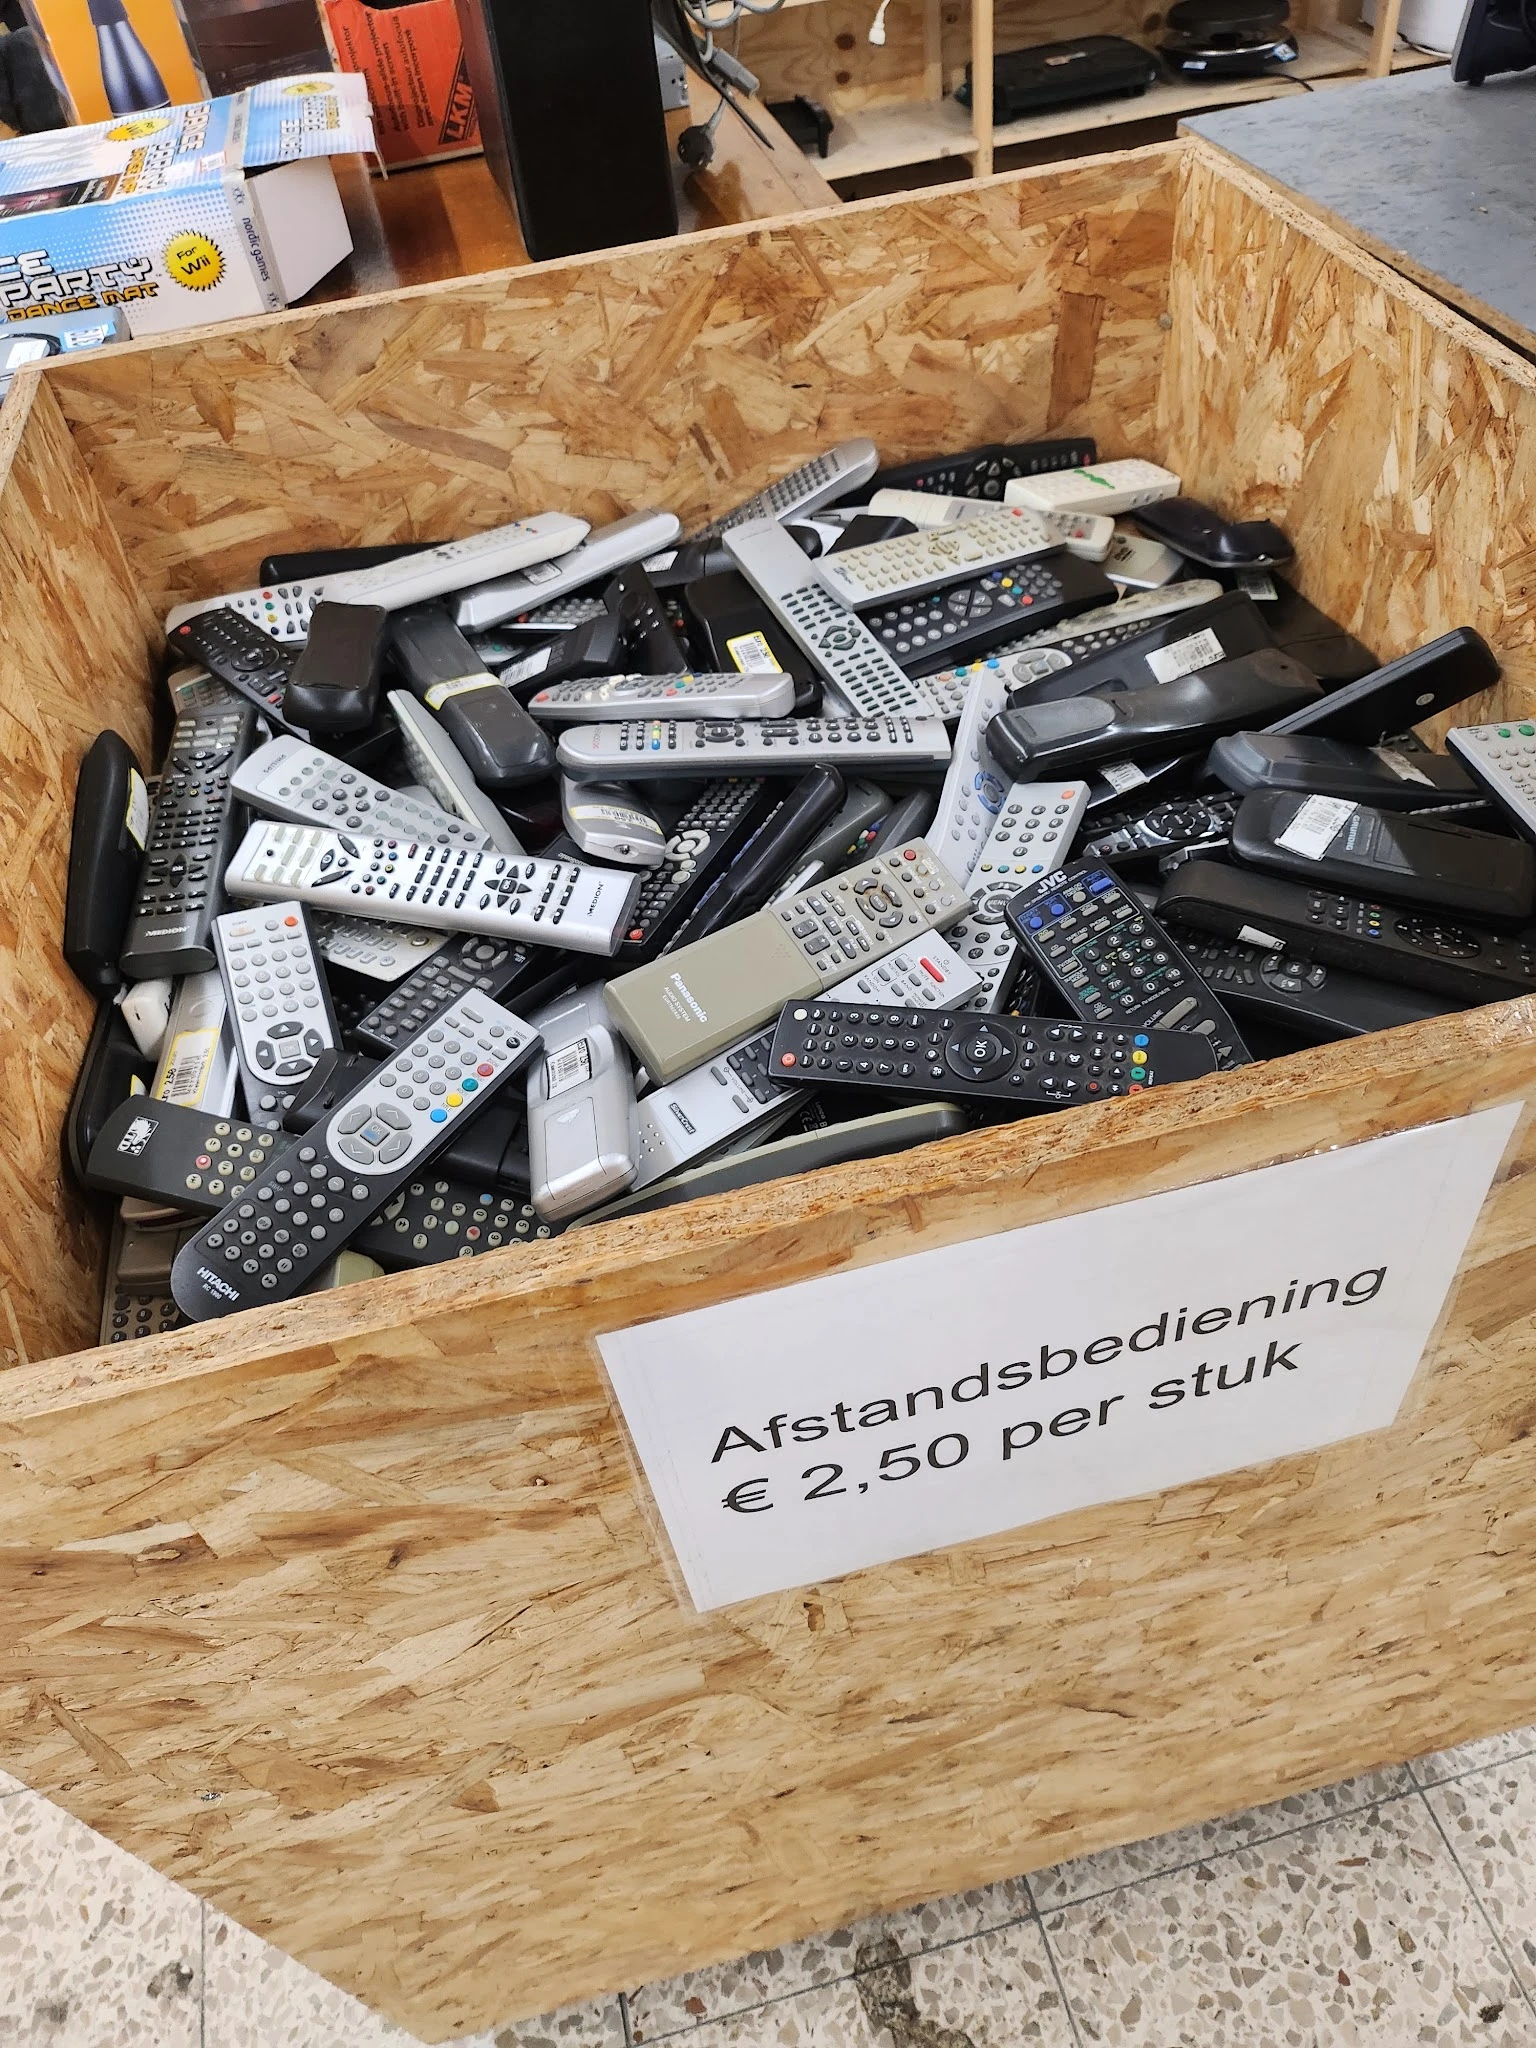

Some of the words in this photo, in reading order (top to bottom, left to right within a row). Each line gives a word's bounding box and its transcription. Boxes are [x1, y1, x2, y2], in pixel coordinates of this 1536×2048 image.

[364, 11, 384, 57] projector
[382, 42, 396, 74] screen
[445, 82, 473, 139] LKM
[242, 217, 260, 248] nordic
[177, 246, 197, 260] For
[180, 254, 211, 275] Wii
[250, 248, 271, 282] games
[7, 293, 101, 322] DANCE
[101, 282, 160, 306] MAT
[1345, 814, 1360, 851] GRUNDIG
[1037, 870, 1068, 895] JVC
[587, 882, 604, 918] MEDION
[144, 926, 188, 938] MEDION
[1065, 927, 1087, 942] TAPE/MD
[932, 955, 953, 976] STANDBY
[1167, 967, 1181, 980] +10
[863, 974, 881, 993] RANDOM
[900, 979, 913, 992] BAND
[1109, 979, 1122, 990] 7/P
[663, 985, 679, 1004] AUDIO
[674, 1000, 692, 1023] SYSTEM
[670, 972, 709, 1024] Panasonic
[1121, 994, 1135, 1005] 10
[1141, 1010, 1164, 1028] VOLUME
[974, 1040, 988, 1058] OK
[371, 1124, 382, 1135] OK
[670, 1102, 695, 1135] SilverCrest
[196, 1266, 241, 1301] HITACHI
[202, 1283, 212, 1293] RC
[711, 1267, 1387, 1464] Afstandsbediening
[722, 1478, 773, 1513] €
[802, 1434, 969, 1501] 2,50
[1003, 1396, 1124, 1461] per
[1149, 1341, 1302, 1410] stuk
